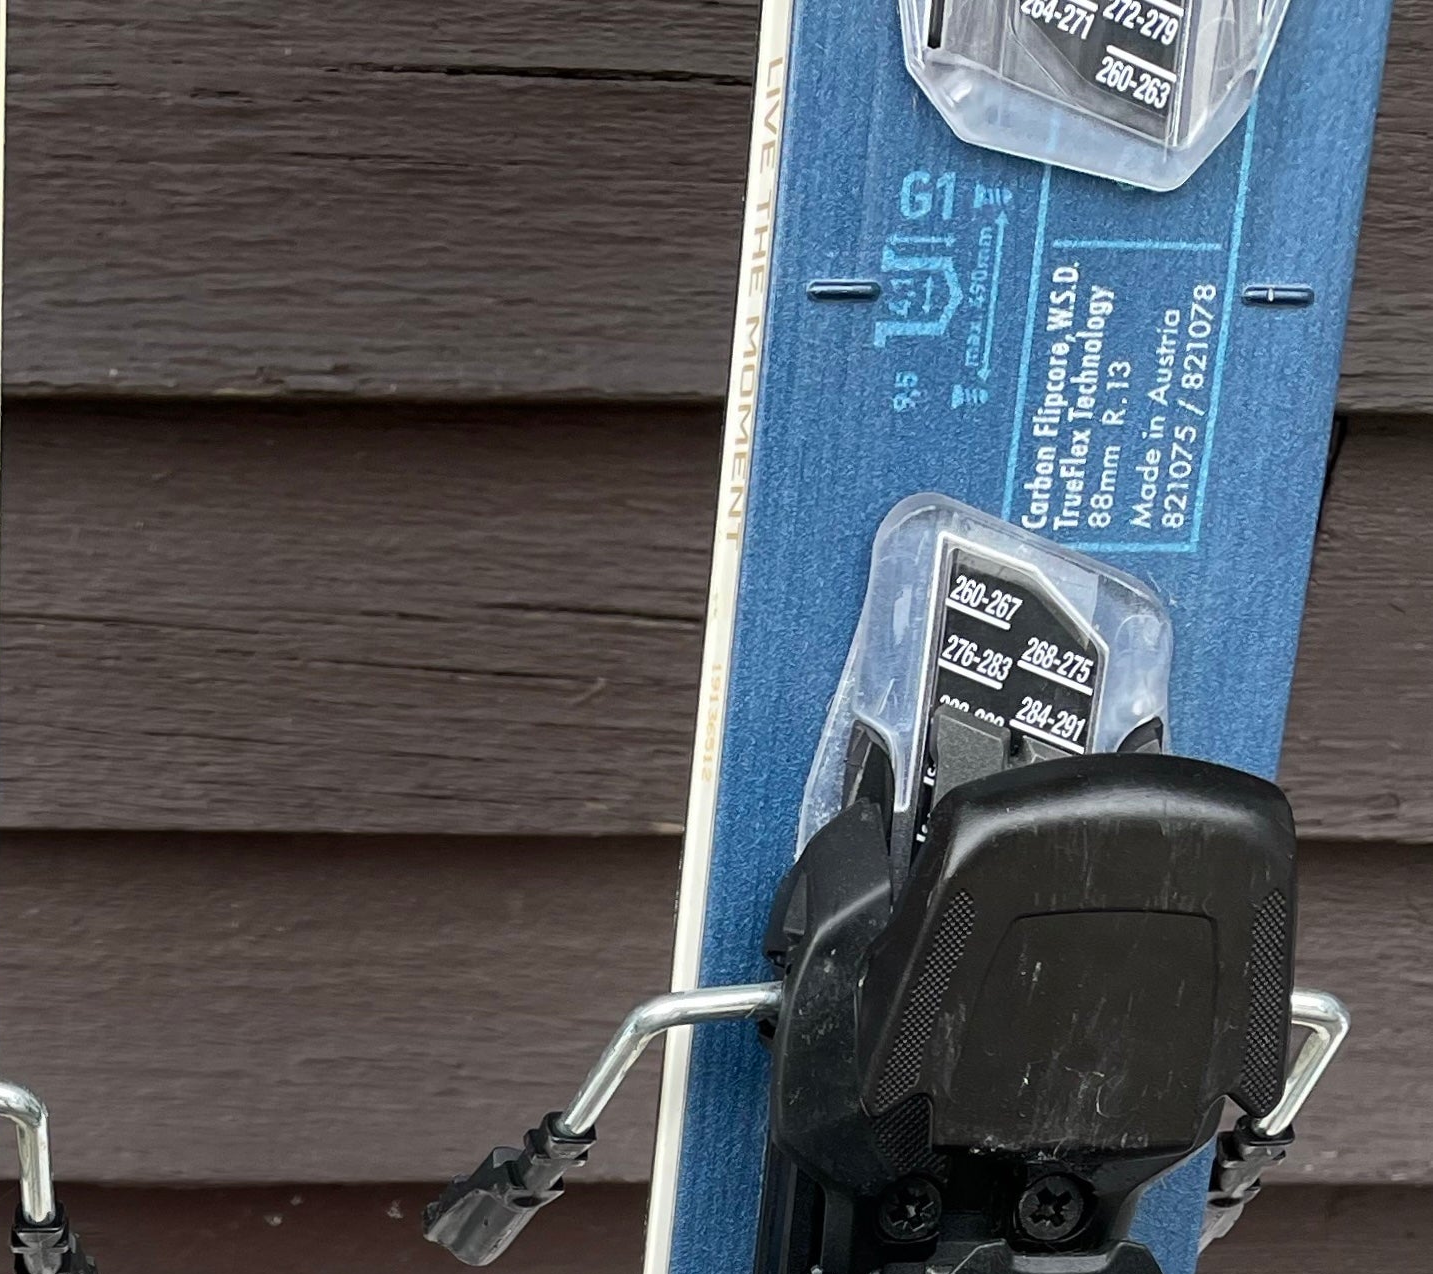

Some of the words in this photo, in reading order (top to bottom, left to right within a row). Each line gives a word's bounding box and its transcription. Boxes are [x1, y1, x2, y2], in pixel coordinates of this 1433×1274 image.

[760, 57, 784, 174] LIVE
[1095, 56, 1171, 110] 260-263
[899, 171, 957, 220] G1
[748, 191, 773, 297] THE
[1032, 337, 1075, 438] Flipcore,
[1067, 285, 1115, 423] Technology
[1147, 309, 1180, 408] Austria
[727, 316, 761, 550] MOMENT
[1142, 416, 1165, 440] in
[1161, 427, 1197, 529] 821075
[1181, 283, 1217, 390] 821078
[1022, 447, 1058, 530] Carbon
[1053, 427, 1092, 530] TrueFlex
[1088, 446, 1121, 529] 88mm
[1129, 448, 1161, 530] Made
[949, 575, 1023, 621] 260-267
[941, 634, 1013, 682] 276-283
[1021, 636, 1094, 684] 268-275
[1015, 696, 1086, 742] 284-291
